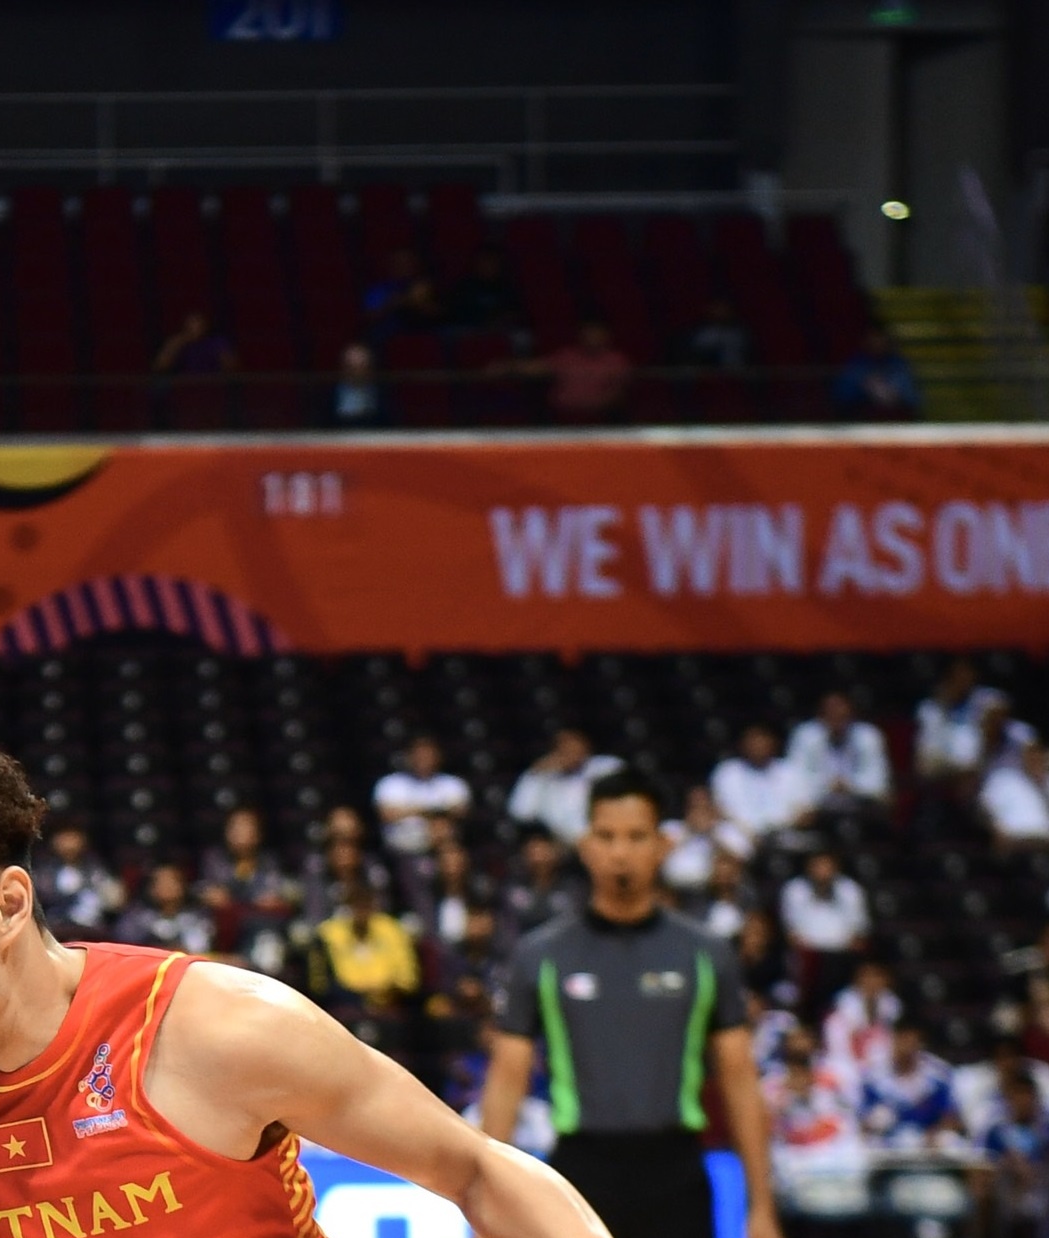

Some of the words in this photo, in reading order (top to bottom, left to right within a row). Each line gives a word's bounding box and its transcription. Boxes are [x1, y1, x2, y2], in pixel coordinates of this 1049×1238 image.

[491, 504, 623, 597] WE
[638, 502, 806, 594] WIN
[819, 500, 924, 594] AS
[932, 499, 1049, 594] ON
